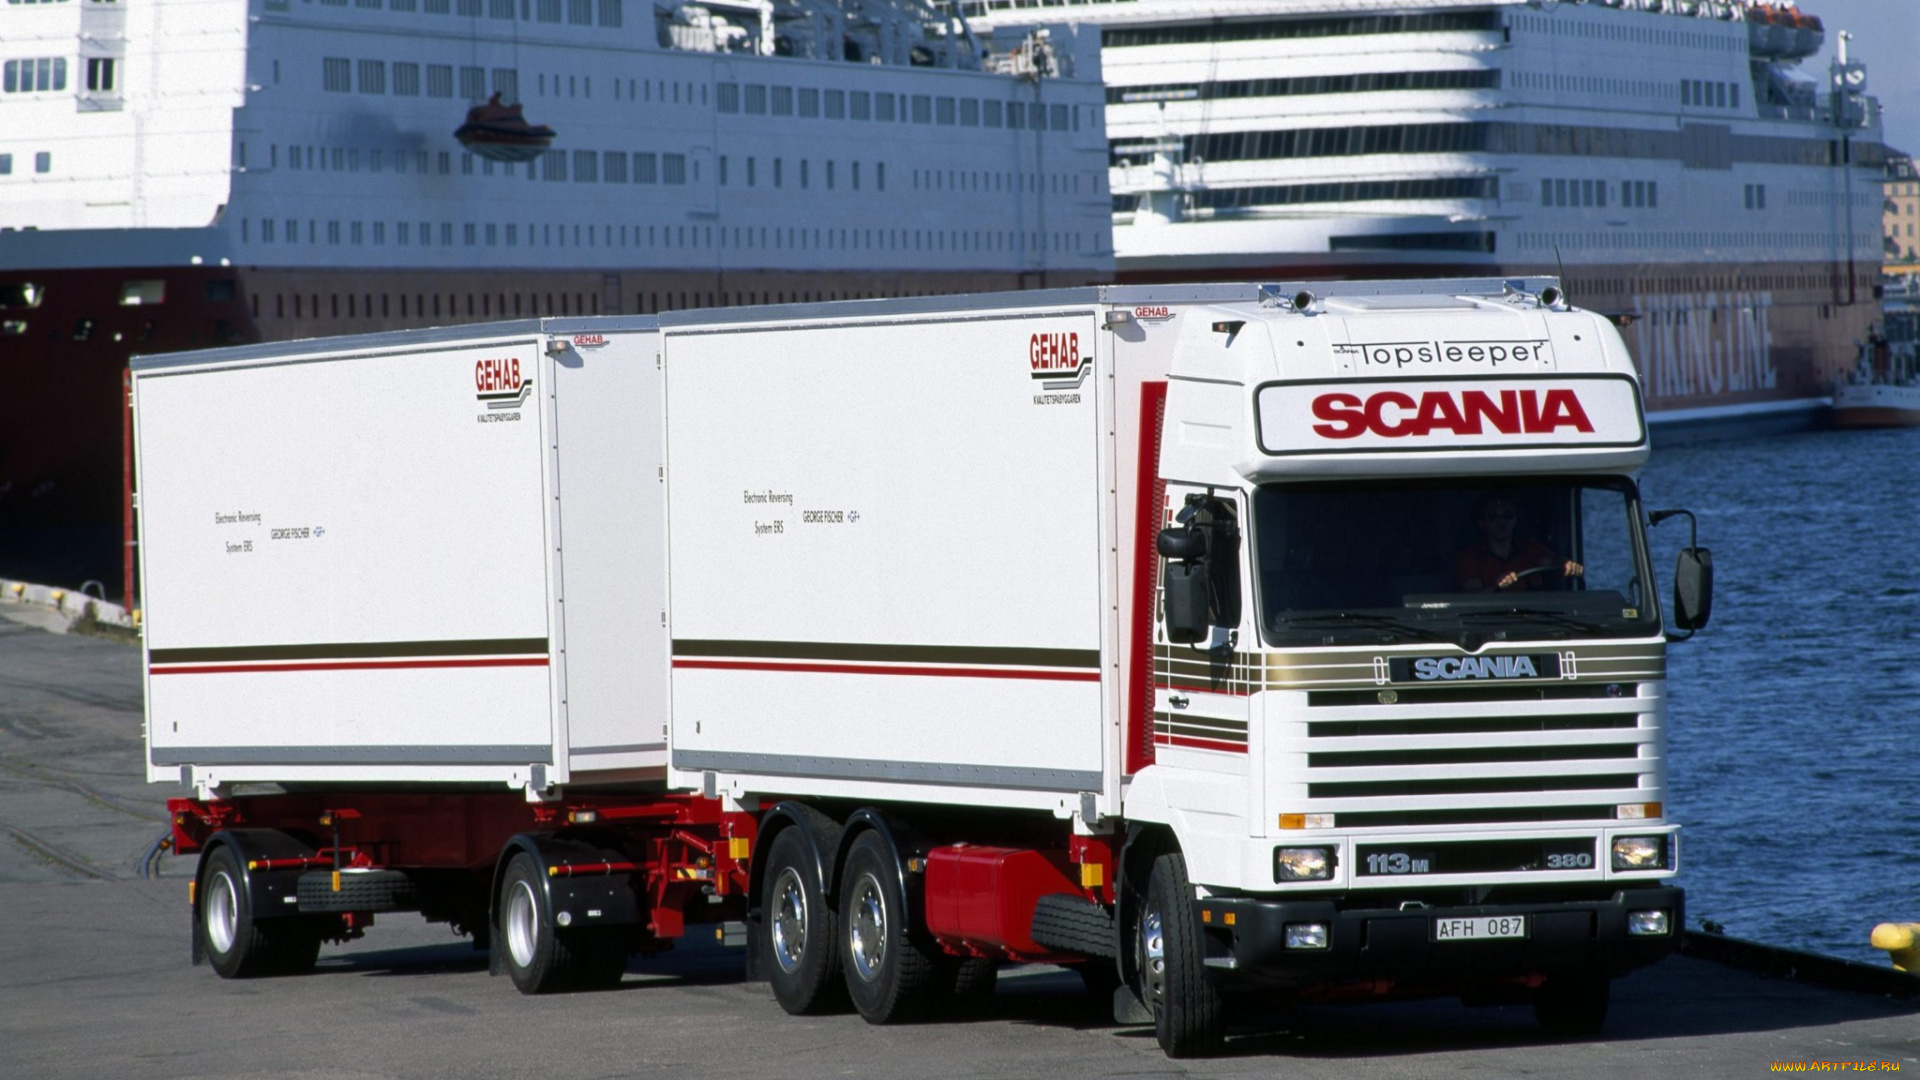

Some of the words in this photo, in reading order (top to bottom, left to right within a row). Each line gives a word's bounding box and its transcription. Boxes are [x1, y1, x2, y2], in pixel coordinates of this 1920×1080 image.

[1135, 306, 1168, 317] GEHAB
[574, 334, 604, 345] GEHAB
[1633, 290, 1723, 398] VIKING
[1725, 290, 1777, 392] LINE
[1029, 332, 1079, 370] GEHAB
[1352, 339, 1549, 368] Topsleeper
[475, 358, 521, 392] GEHAB
[1311, 389, 1595, 439] SCANIA
[743, 490, 767, 504] Electronic
[768, 489, 793, 506] Reversing
[215, 512, 237, 524] Electronic
[238, 510, 261, 526] Reversing
[803, 510, 823, 523] GEORGE
[824, 510, 844, 523] FISCHER
[271, 527, 291, 540] GEORGE
[291, 527, 310, 540] FISCHER
[754, 520, 773, 536] System
[773, 520, 784, 534] ERS
[226, 541, 242, 555] System
[243, 540, 254, 552] ERS
[1414, 655, 1538, 680] SCANIA
[1547, 852, 1592, 869] 380
[1439, 919, 1475, 938] AFH
[1487, 917, 1523, 937] 087
